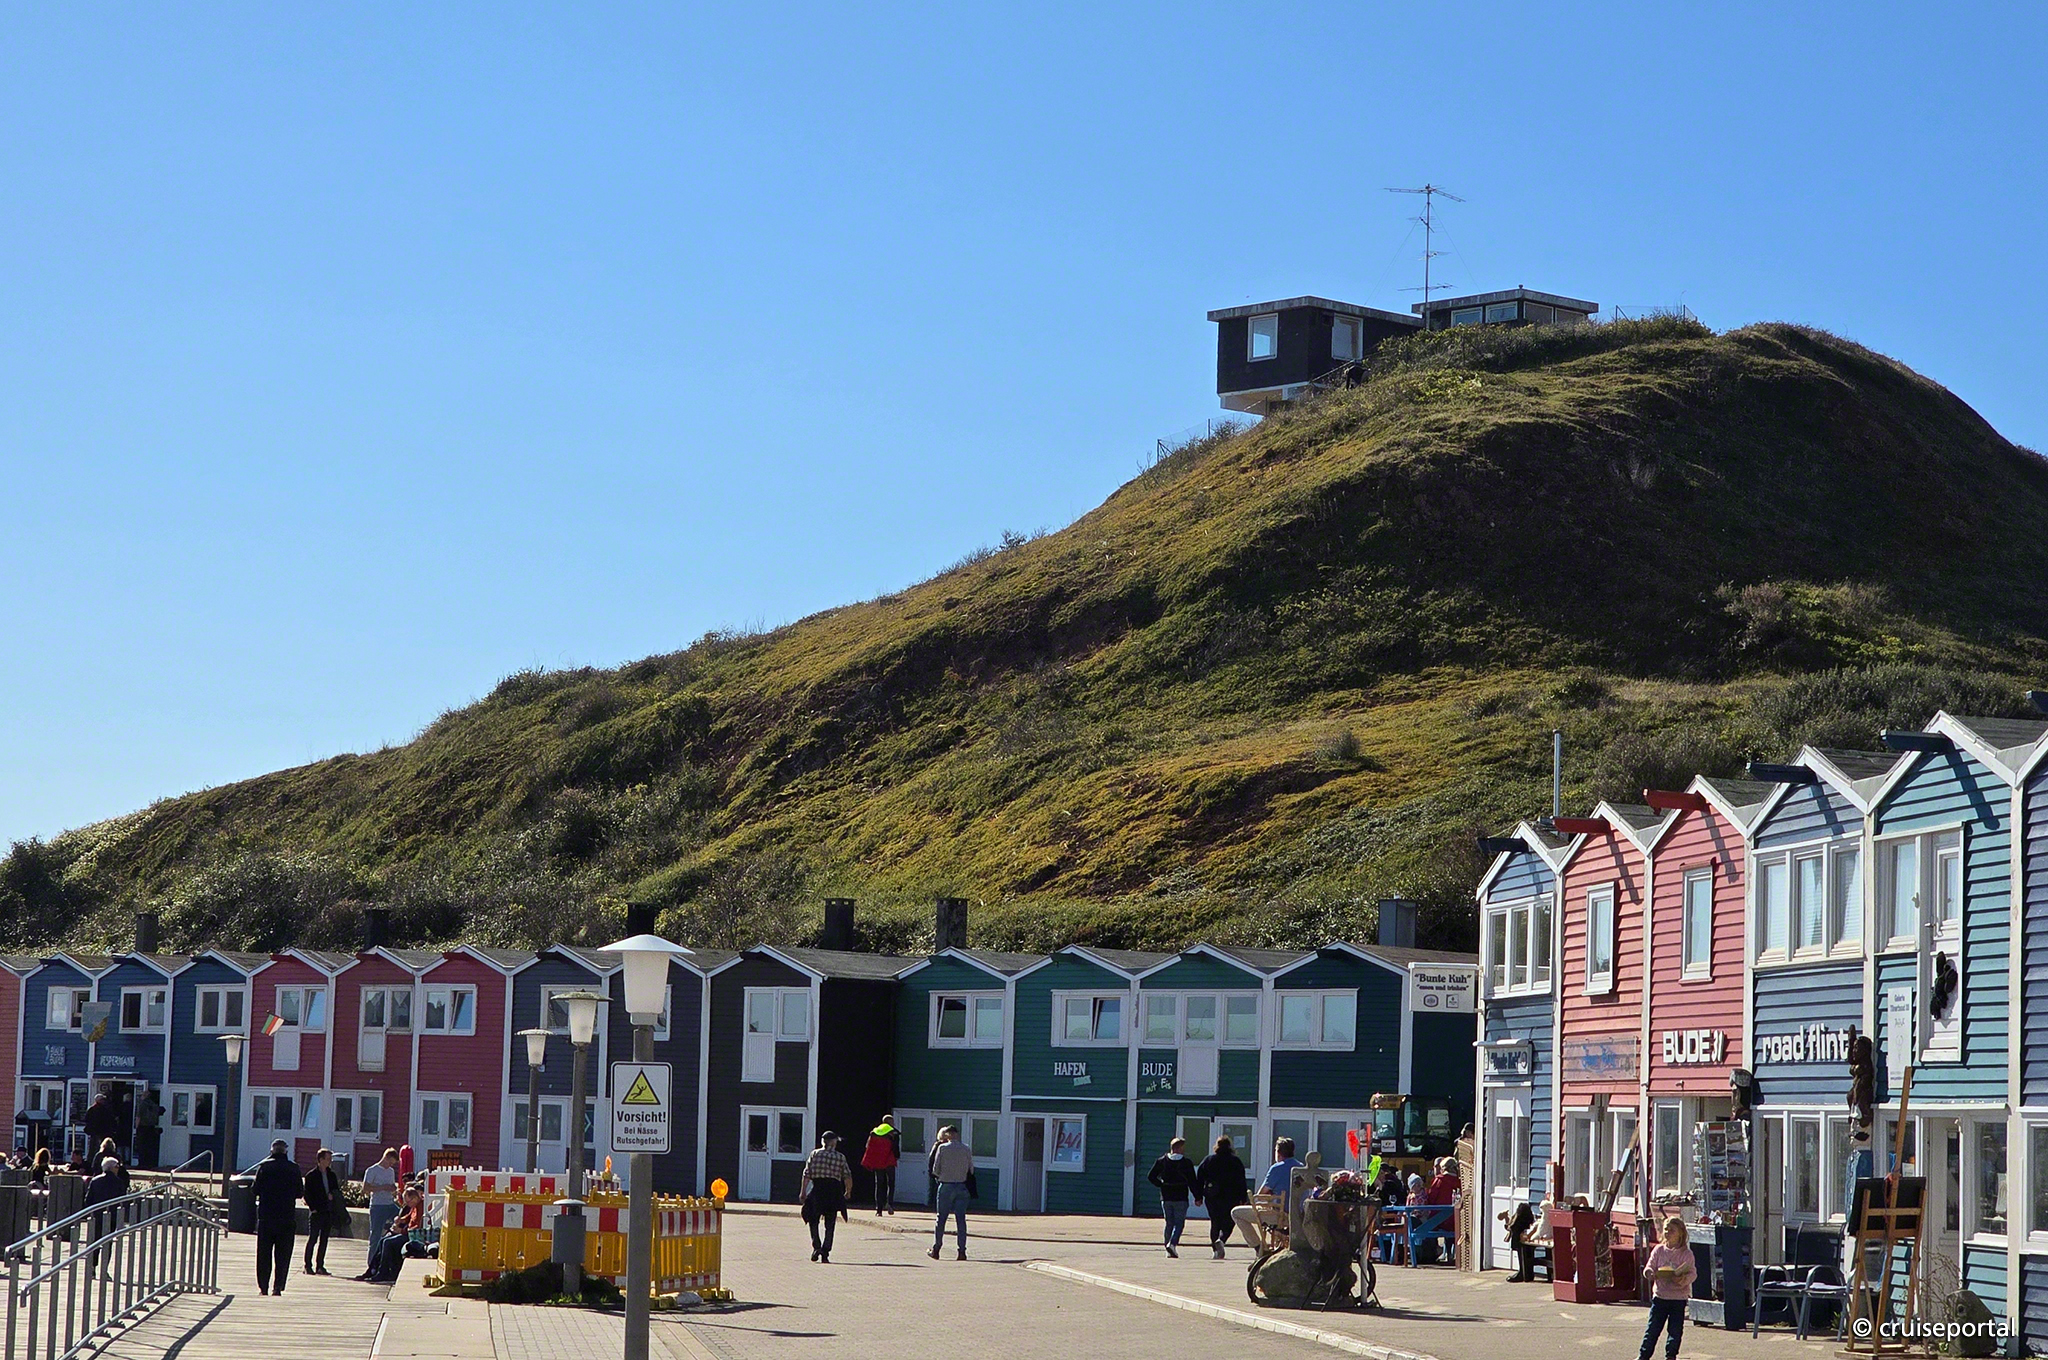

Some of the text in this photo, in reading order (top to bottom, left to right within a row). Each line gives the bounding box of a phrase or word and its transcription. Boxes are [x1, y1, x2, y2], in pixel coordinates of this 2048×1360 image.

[1663, 1029, 1711, 1064] BUDE
[1054, 1062, 1173, 1076] HAFEN BUDE
[616, 1111, 666, 1122] Vorsicht!
[616, 1136, 665, 1145] Rutschgefahr!
